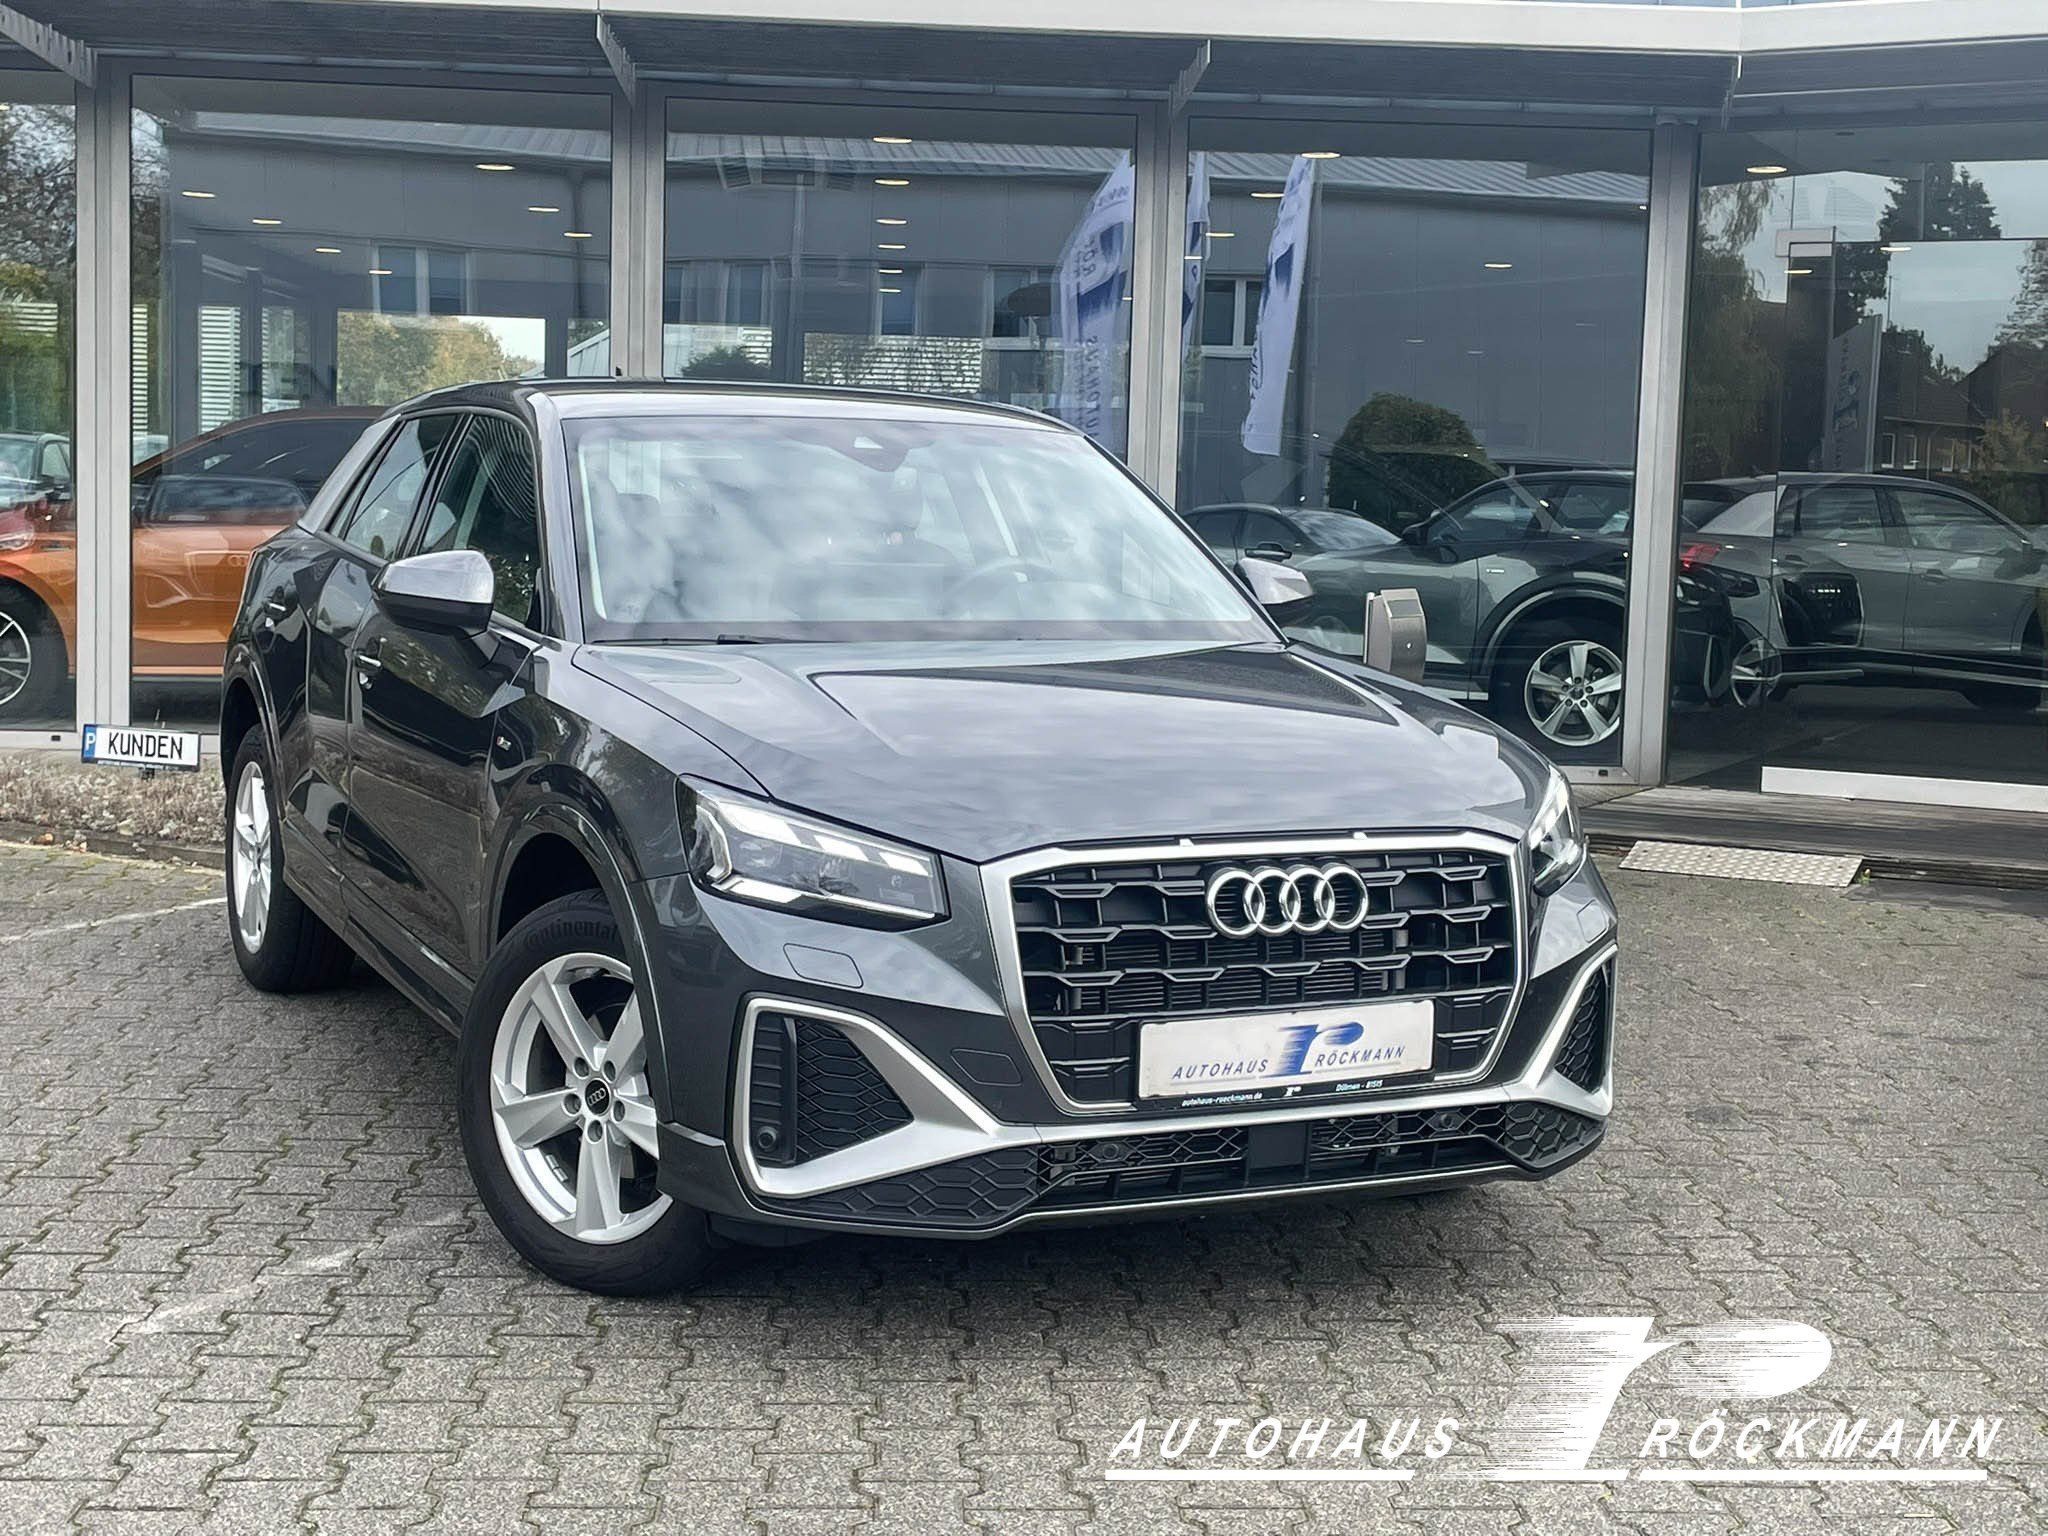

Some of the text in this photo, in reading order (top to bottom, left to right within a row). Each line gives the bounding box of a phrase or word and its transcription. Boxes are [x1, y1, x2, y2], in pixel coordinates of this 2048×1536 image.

[85, 732, 183, 760] P KUNDEN
[1171, 1059, 1269, 1080] AUTOHAUS
[1314, 1045, 1406, 1067] RÖCKMANN
